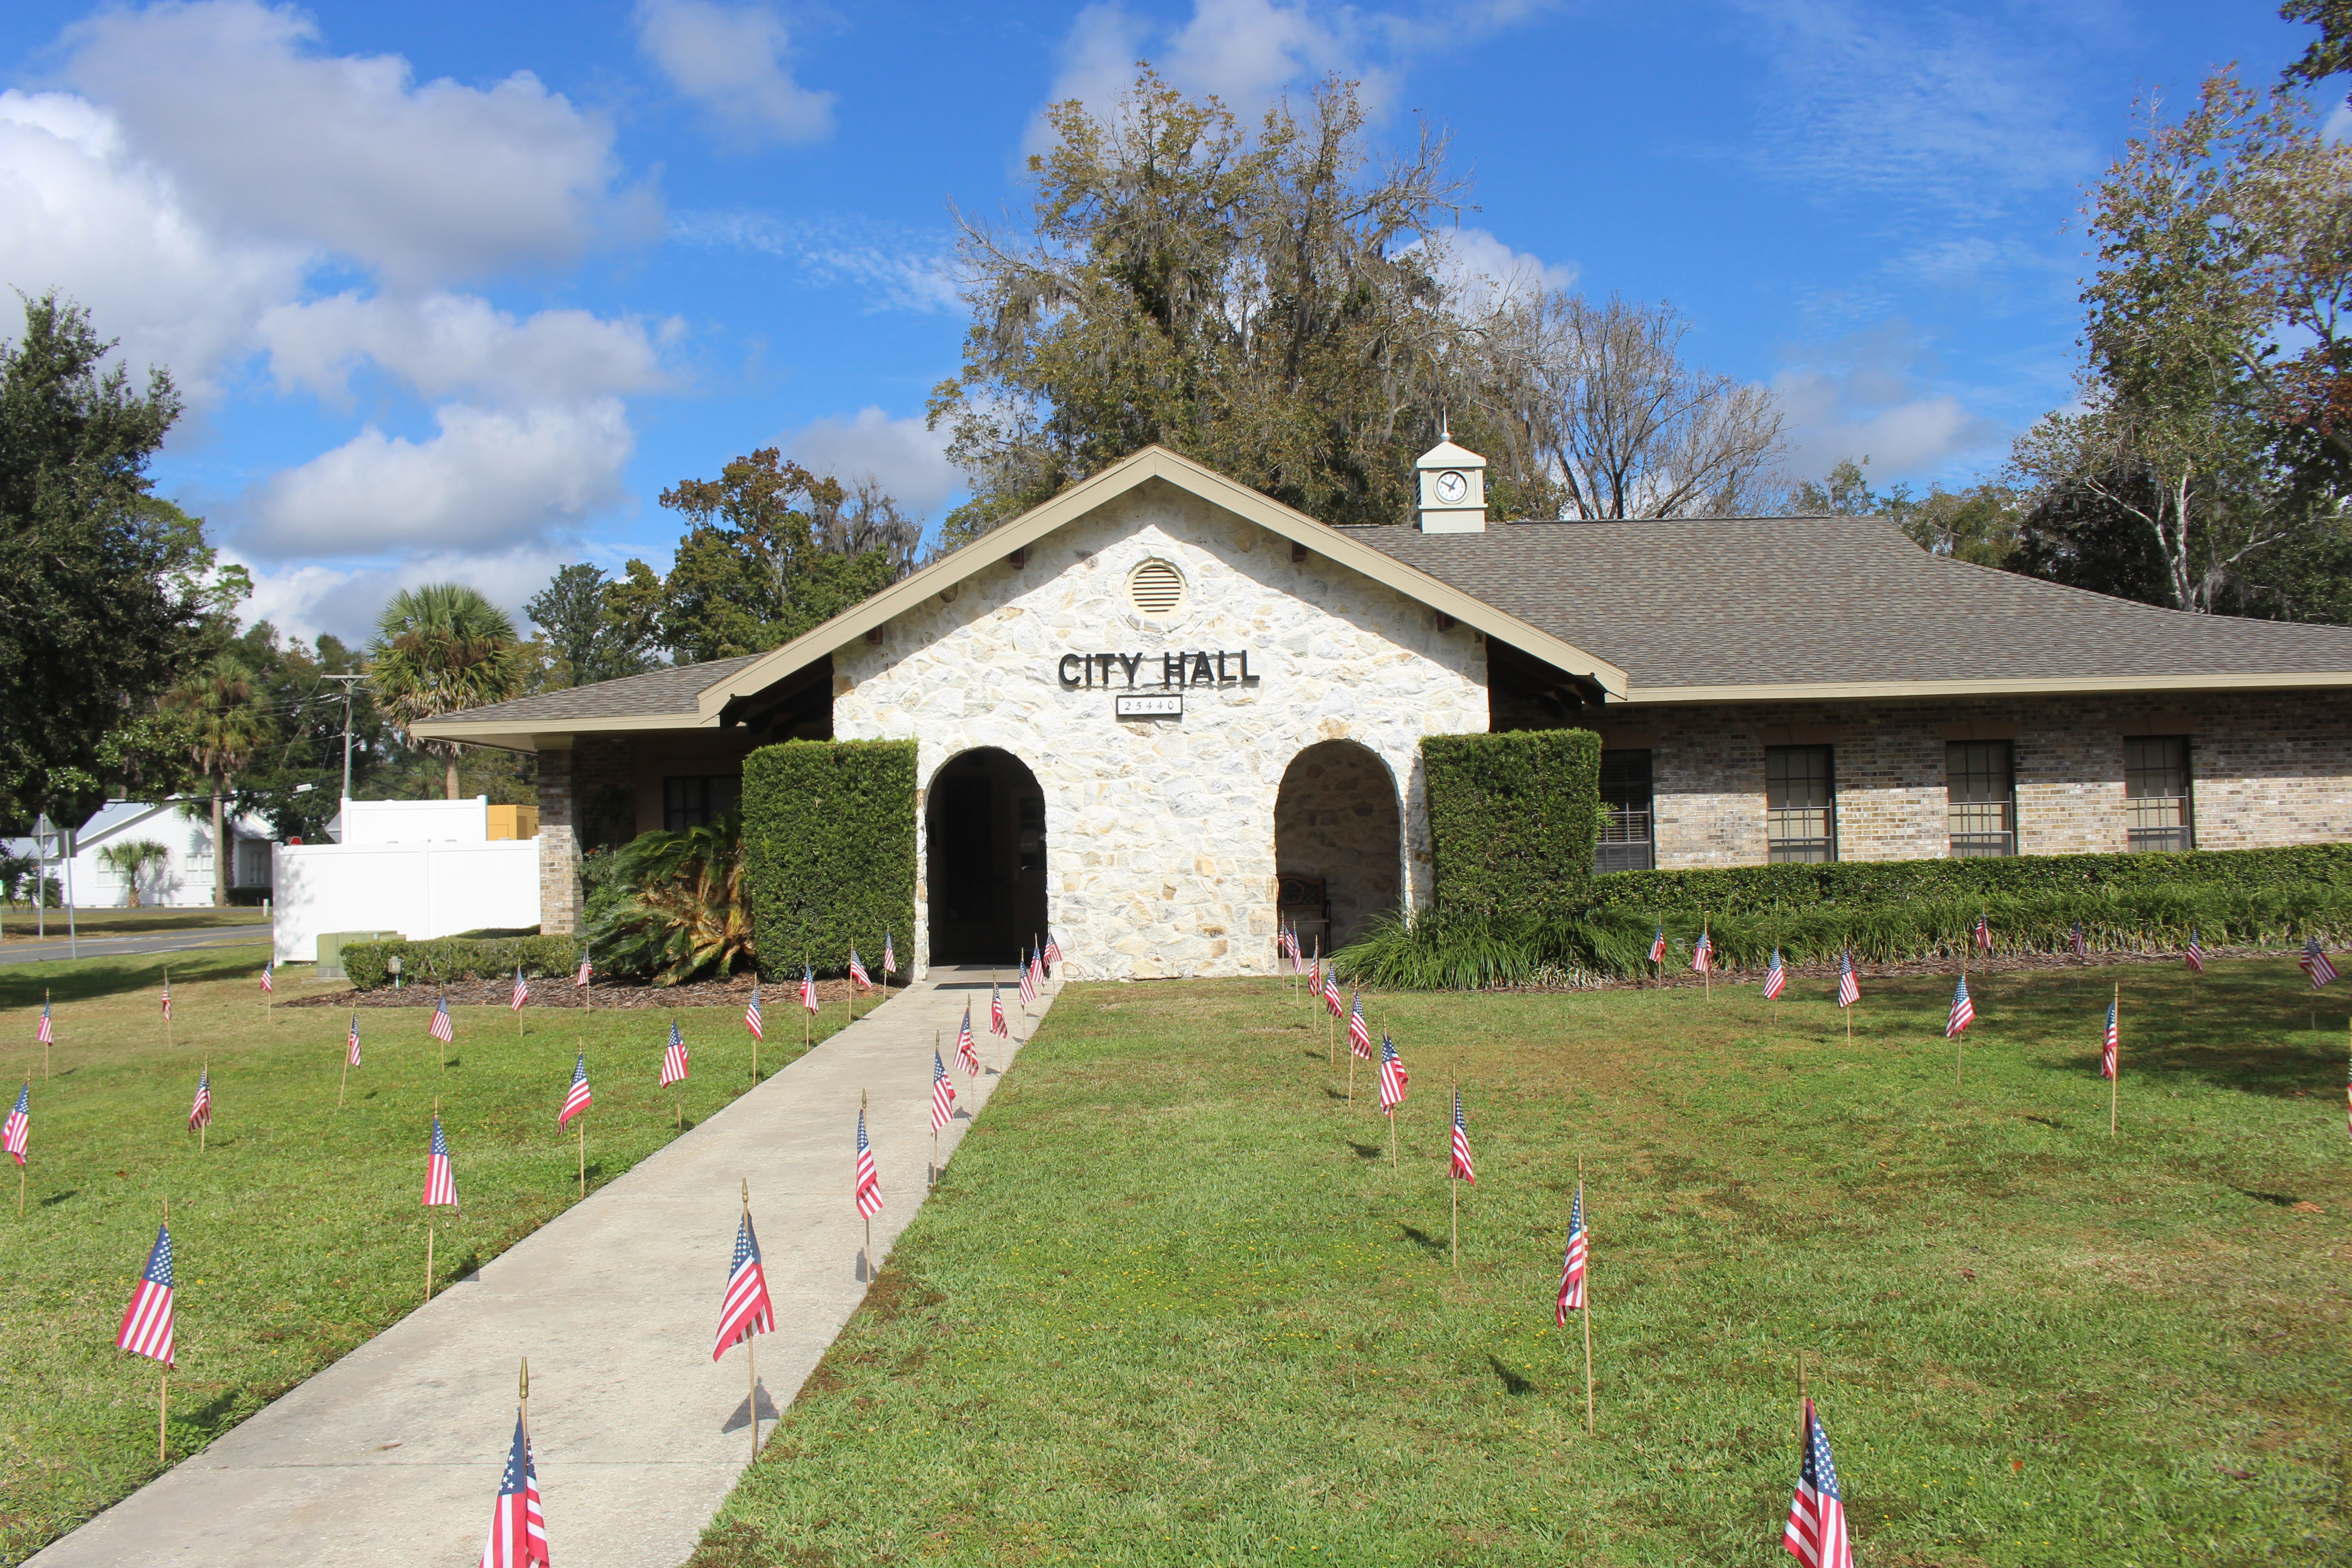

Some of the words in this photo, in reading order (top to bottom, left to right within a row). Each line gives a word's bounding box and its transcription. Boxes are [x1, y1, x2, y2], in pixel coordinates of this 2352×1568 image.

[1059, 652, 1143, 685] CITY
[1164, 650, 1260, 684] HALL
[1124, 700, 1174, 711] 25440
